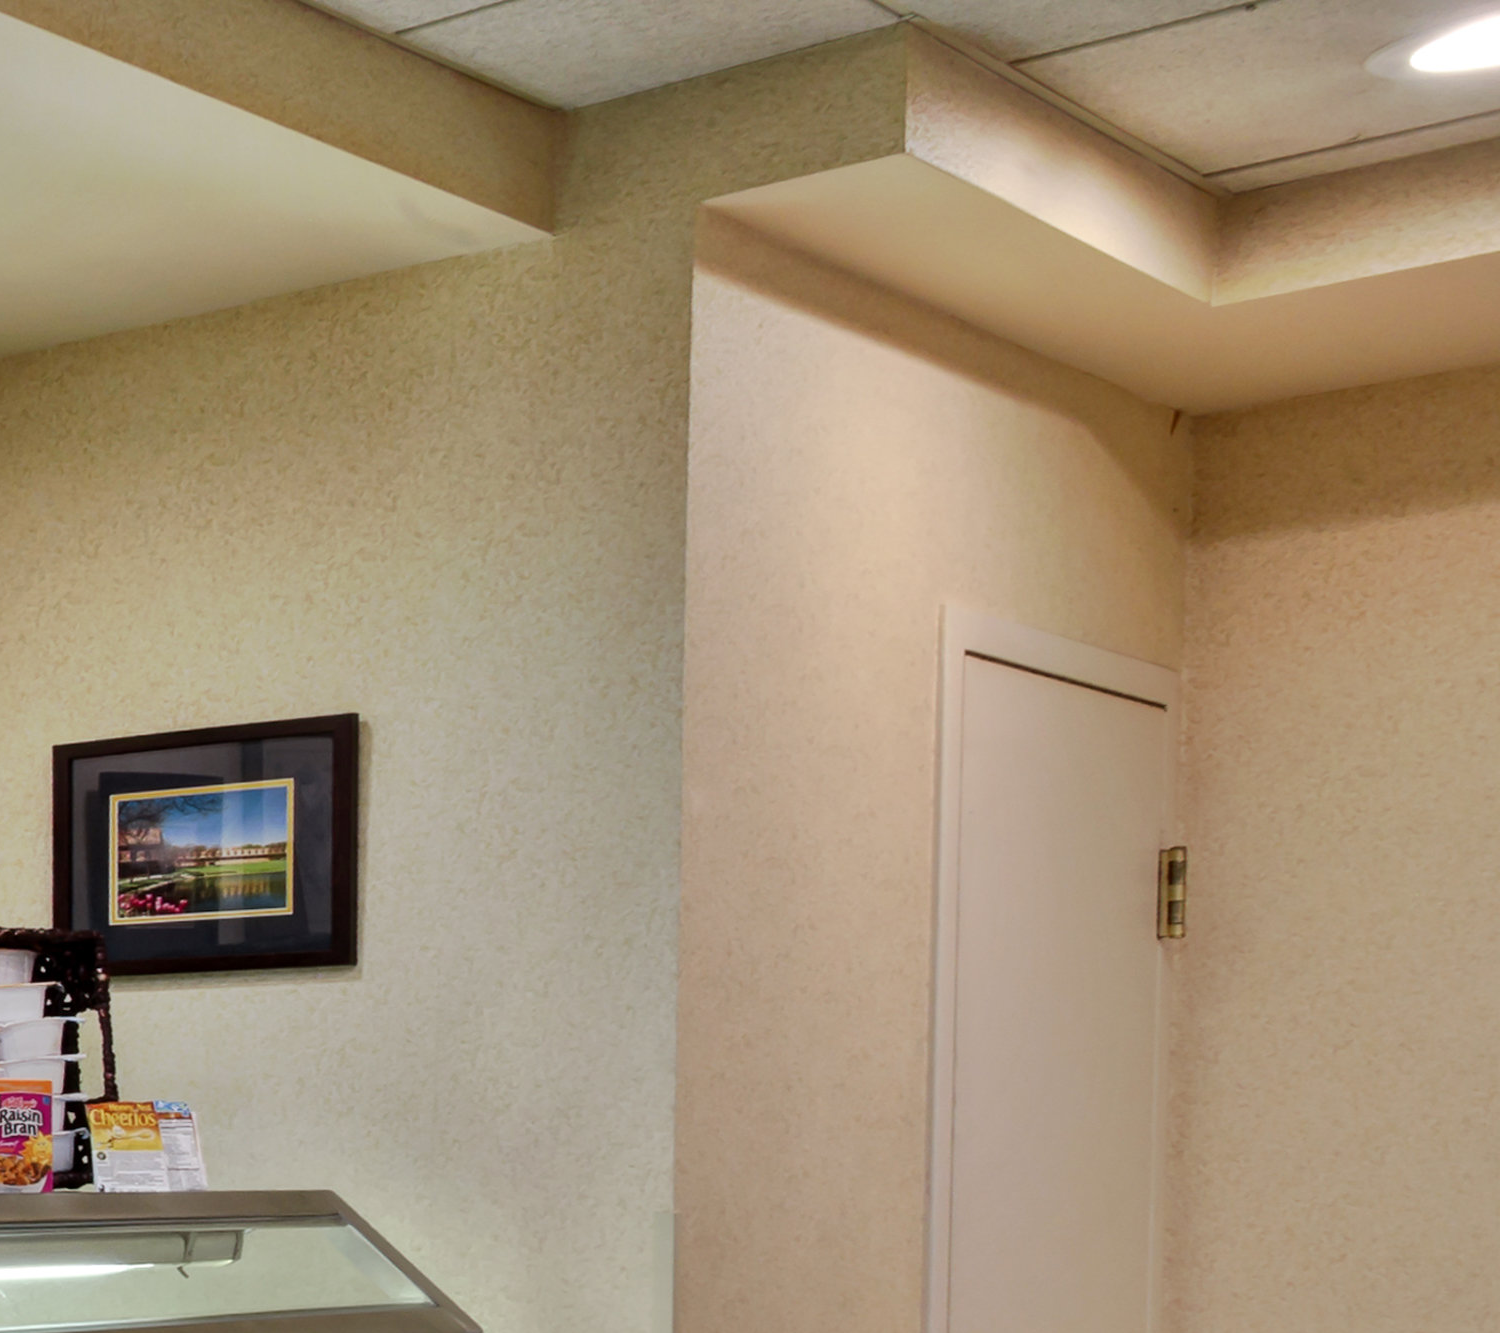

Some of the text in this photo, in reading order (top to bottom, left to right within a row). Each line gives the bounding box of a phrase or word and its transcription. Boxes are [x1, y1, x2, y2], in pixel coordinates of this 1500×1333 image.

[0, 1109, 41, 1124] Raisin
[90, 1108, 158, 1127] Cheerios
[3, 1122, 37, 1136] Bran
